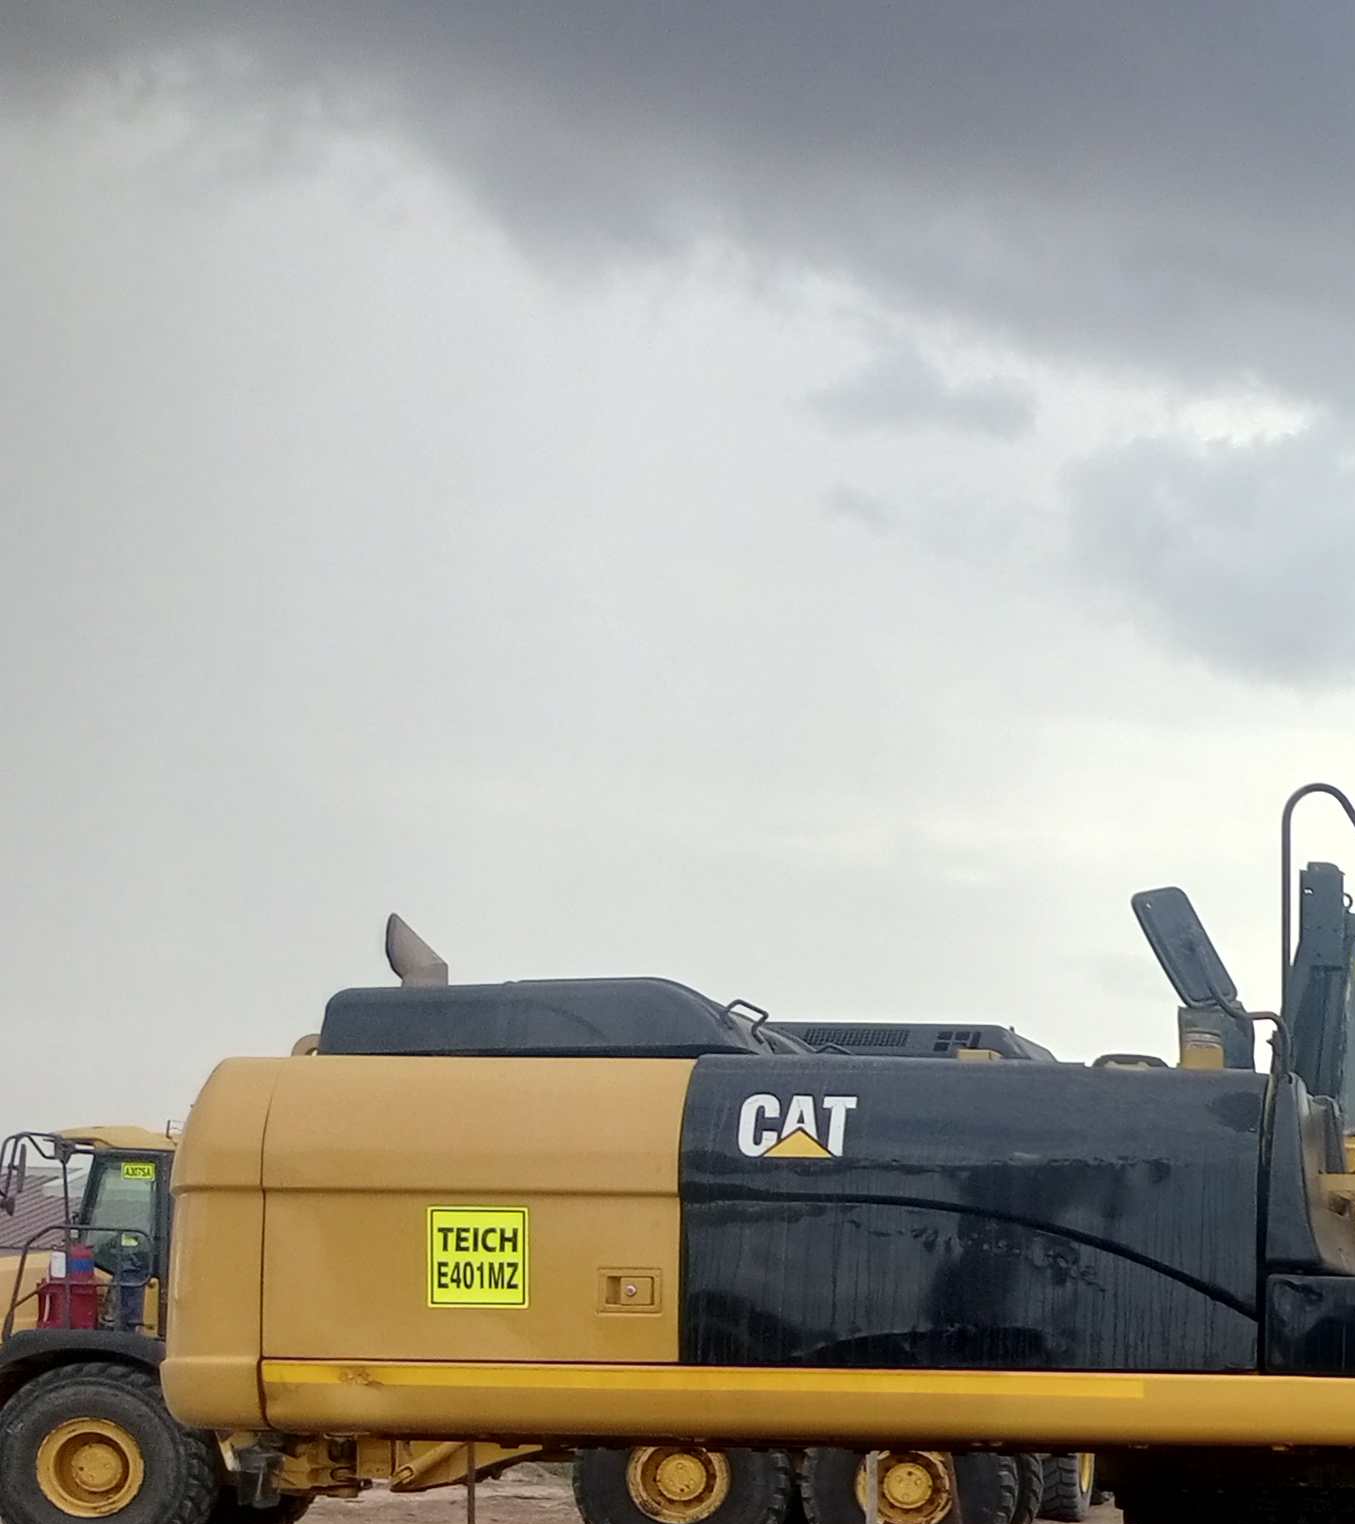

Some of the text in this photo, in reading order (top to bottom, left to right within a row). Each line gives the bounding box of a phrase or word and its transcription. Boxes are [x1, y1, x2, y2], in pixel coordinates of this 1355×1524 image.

[738, 1093, 858, 1157] CAT
[437, 1226, 519, 1252] TEICH
[437, 1261, 519, 1290] E401MZ
